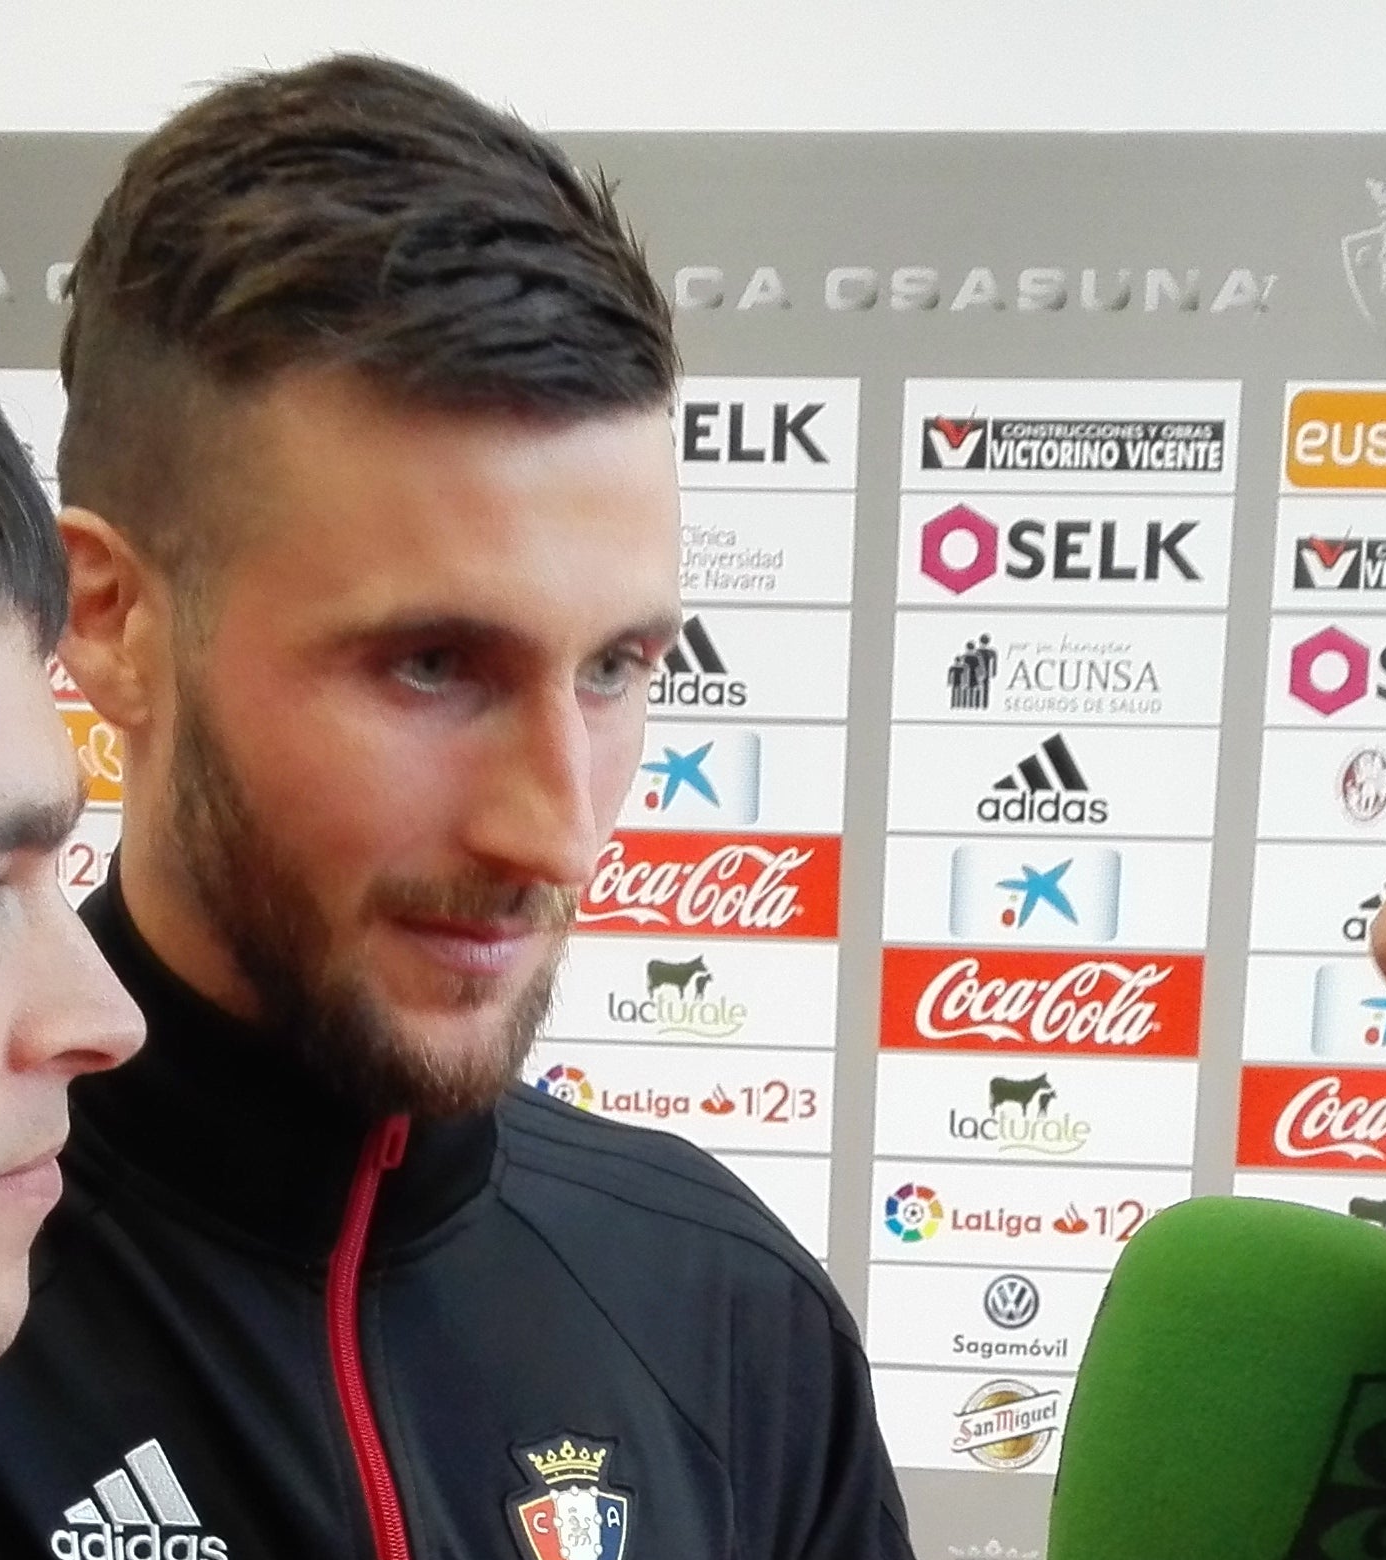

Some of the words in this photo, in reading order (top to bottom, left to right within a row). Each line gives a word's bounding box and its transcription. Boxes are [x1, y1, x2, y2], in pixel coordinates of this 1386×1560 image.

[683, 402, 831, 465] ELK
[1001, 422, 1146, 440] CONSTRUCCIONES
[989, 439, 1120, 470] VICTORINO
[1124, 440, 1223, 471] VICENTE
[1004, 518, 1204, 582] SELK
[647, 672, 749, 708] didas
[1006, 658, 1161, 693] ACUNSA
[1004, 696, 1079, 713] SEGUROS
[976, 789, 1109, 825] adidas
[608, 992, 749, 1028] lacturale
[915, 957, 1175, 1046] Coca-Cola
[602, 1083, 691, 1120] LaLiga
[949, 1108, 1092, 1142] lacturale
[951, 1208, 1042, 1238] LaLiga
[953, 1333, 1069, 1359] Sagamóvil
